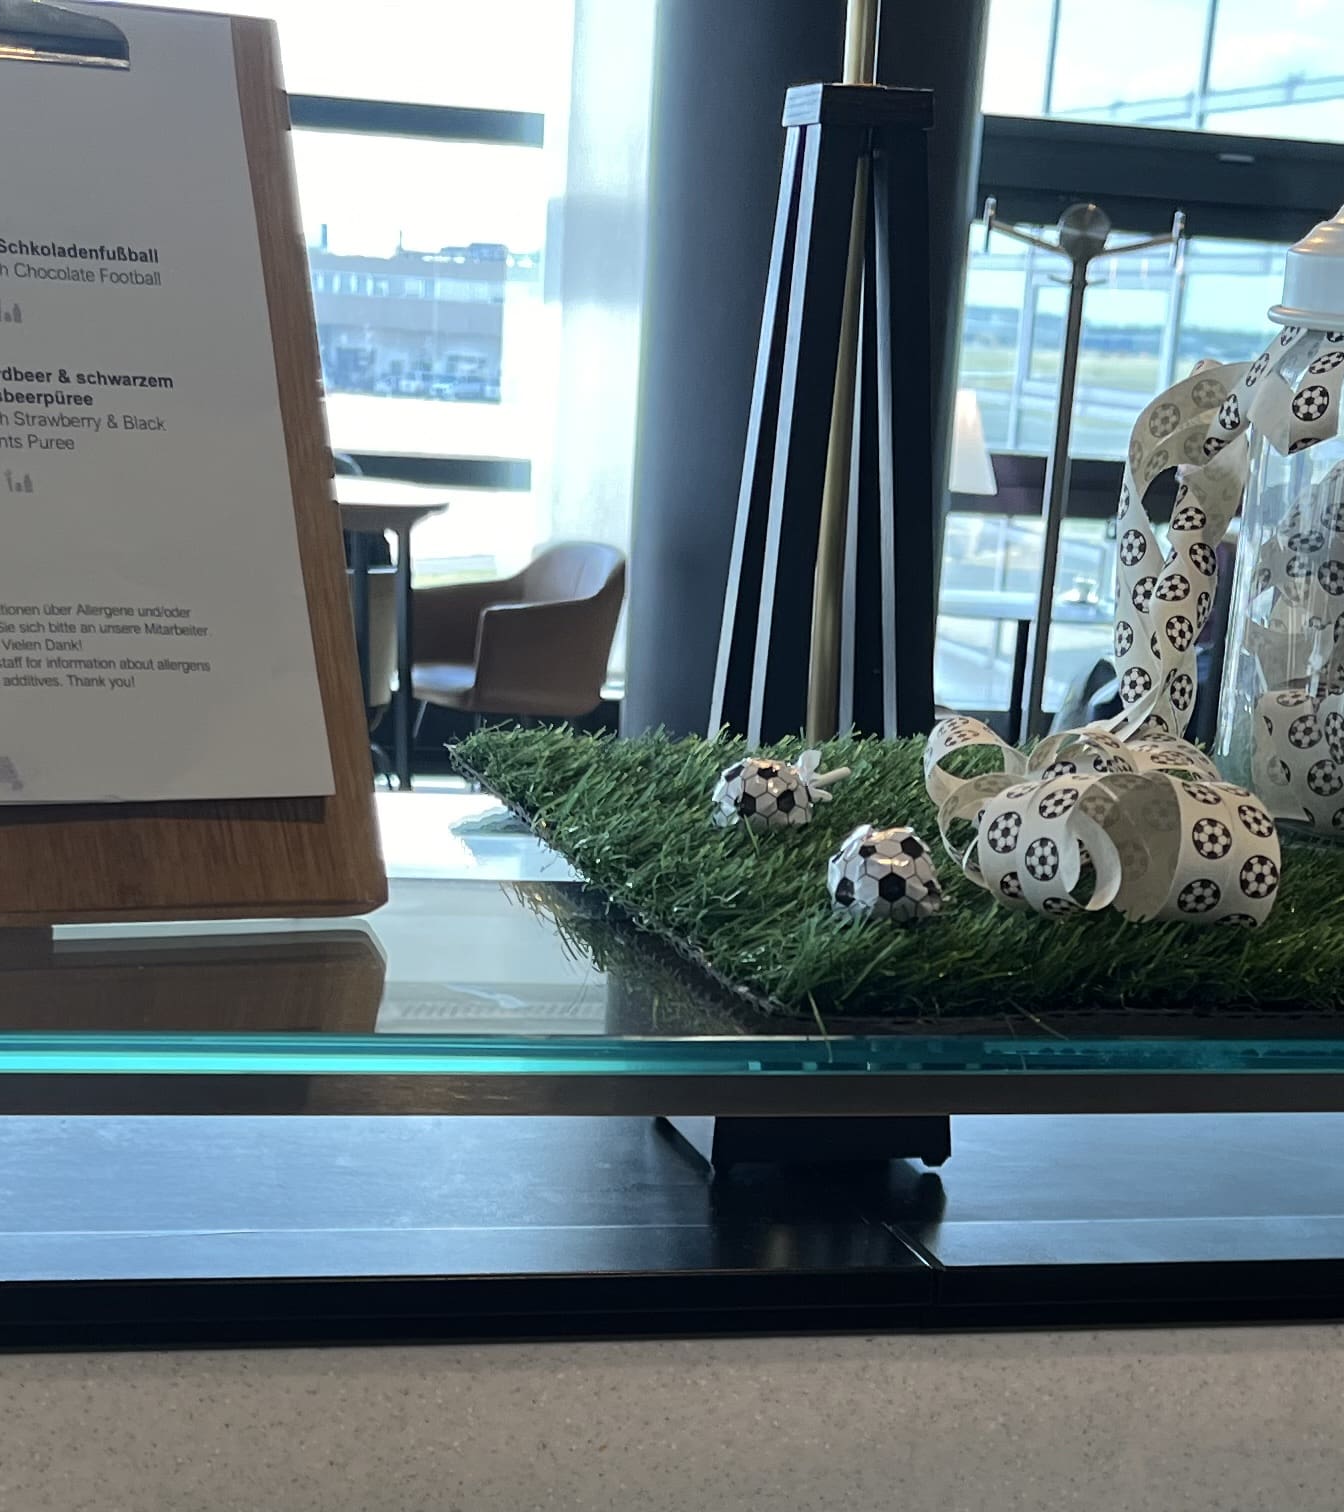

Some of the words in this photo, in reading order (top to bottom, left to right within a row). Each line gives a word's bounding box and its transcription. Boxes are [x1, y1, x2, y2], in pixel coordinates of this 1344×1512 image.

[14, 262, 95, 282] Chocolate
[100, 268, 162, 286] Football
[58, 368, 71, 384] &
[76, 371, 174, 389] schwarzem
[14, 411, 101, 432] Strawberry
[107, 414, 119, 429] &
[123, 415, 168, 431] Black
[27, 434, 75, 450] Puree
[43, 603, 72, 617] über
[76, 604, 134, 619] Allergene
[138, 606, 191, 619] und/oder
[19, 621, 46, 634] sich
[48, 622, 77, 634] bitte
[80, 624, 96, 634] an
[99, 624, 142, 635] unsere
[1, 638, 42, 651] Vielen
[45, 638, 83, 651] Dank!
[25, 656, 43, 669] for
[46, 657, 117, 670] information
[119, 657, 154, 671] about
[157, 659, 212, 673] allergens
[3, 674, 63, 688] additives.
[66, 674, 106, 688] Thank
[109, 676, 136, 690] you!
